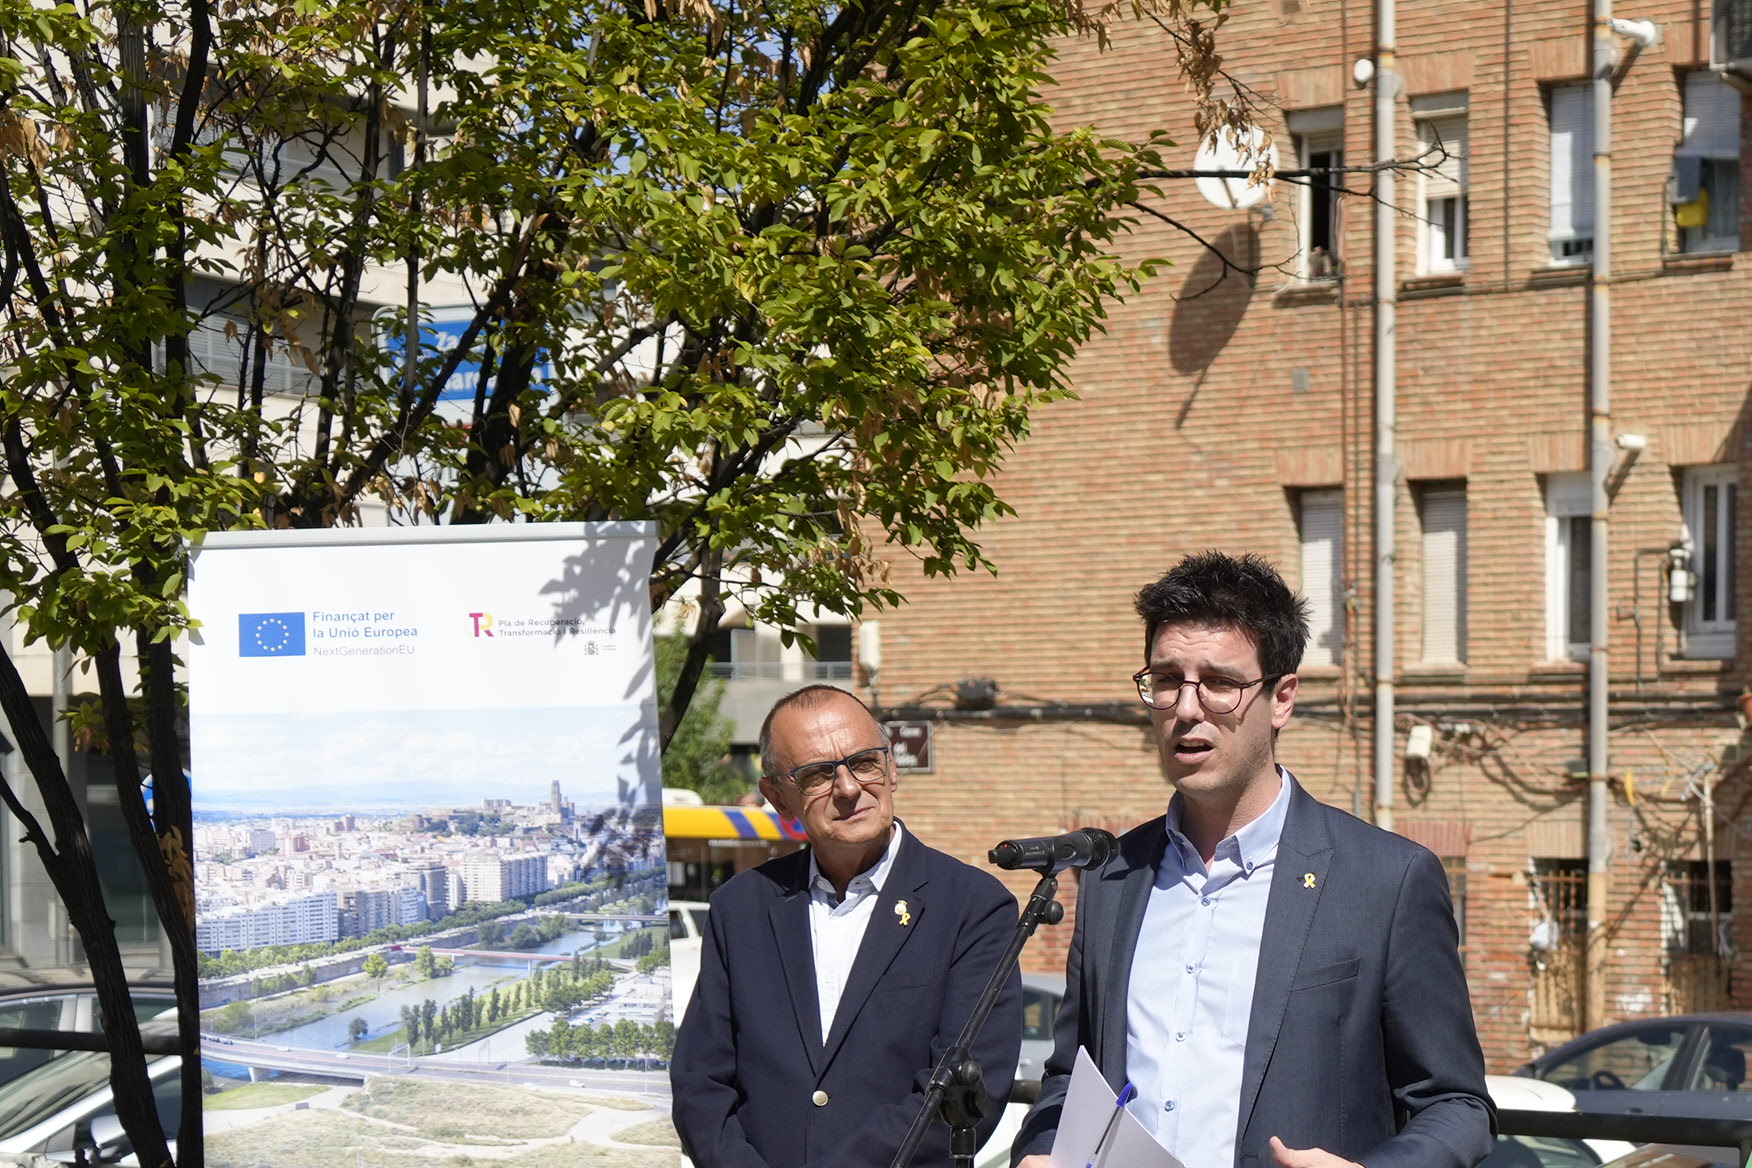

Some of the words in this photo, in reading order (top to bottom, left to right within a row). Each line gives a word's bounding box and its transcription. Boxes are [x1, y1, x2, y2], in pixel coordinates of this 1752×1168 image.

[313, 611, 370, 623] Finançat
[374, 612, 395, 623] per
[514, 619, 526, 627] de
[313, 627, 324, 638] la
[328, 627, 360, 638] Unió
[364, 626, 418, 639] Europea
[313, 644, 415, 656] NextGenerationEU
